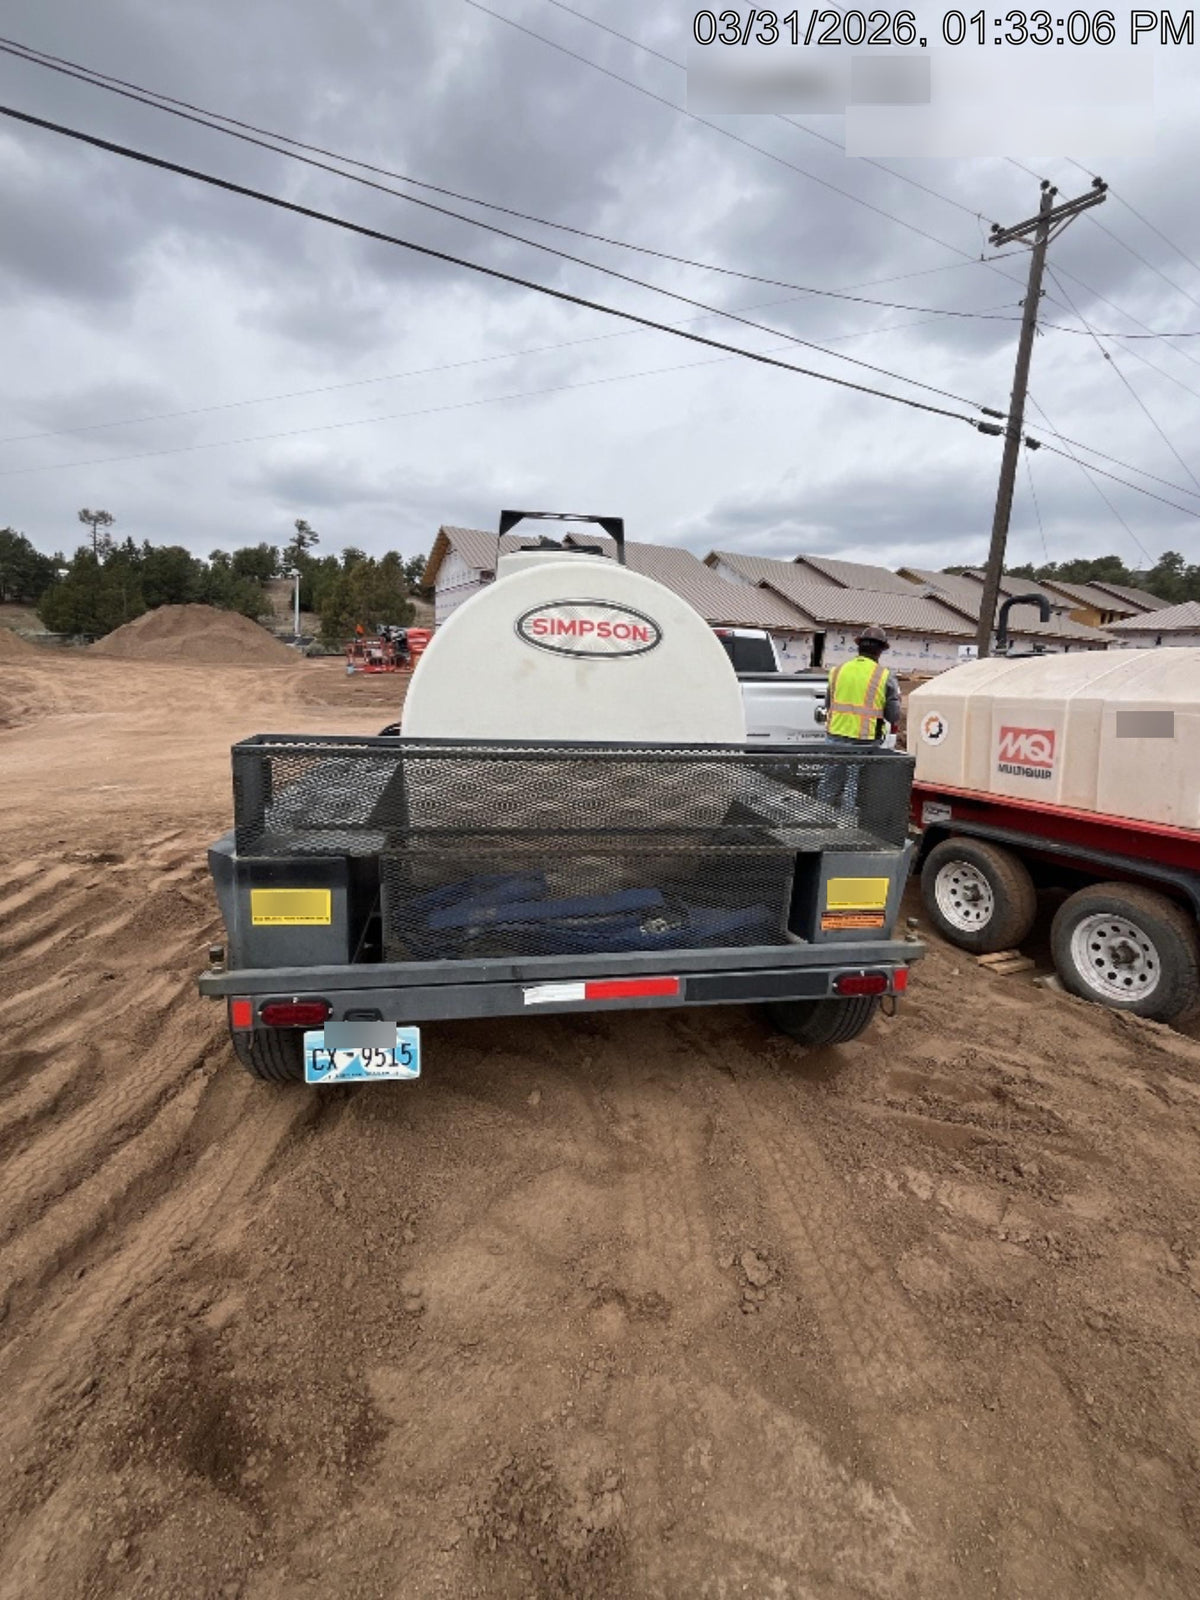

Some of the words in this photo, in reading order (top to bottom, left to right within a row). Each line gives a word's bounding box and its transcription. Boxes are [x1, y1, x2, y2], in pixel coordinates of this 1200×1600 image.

[532, 618, 649, 642] SIMPSON
[998, 731, 1054, 764] MQ
[998, 763, 1052, 780] MULTIQUIP
